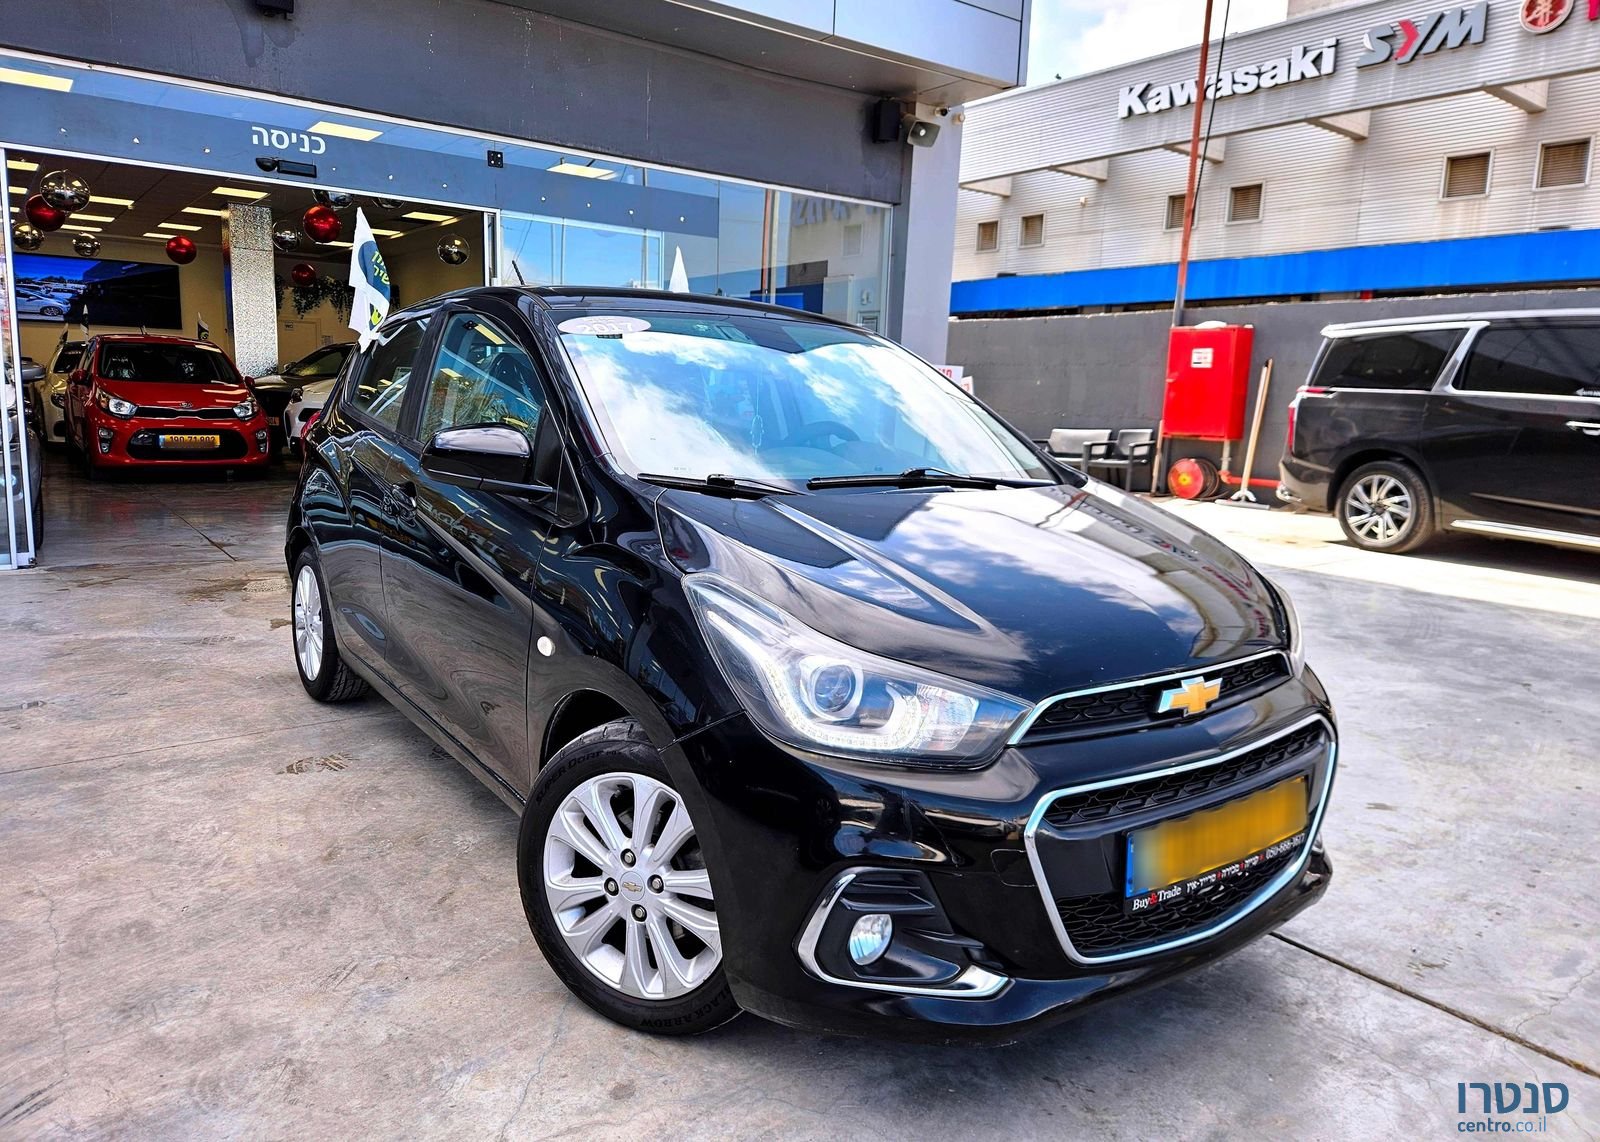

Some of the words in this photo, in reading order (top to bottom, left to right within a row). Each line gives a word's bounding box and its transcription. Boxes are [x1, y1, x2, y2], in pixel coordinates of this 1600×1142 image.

[1356, 0, 1488, 69] SYM
[1118, 37, 1339, 119] Kawasaki
[251, 126, 326, 155] כניסה
[1132, 886, 1182, 911] Buy&Trade
